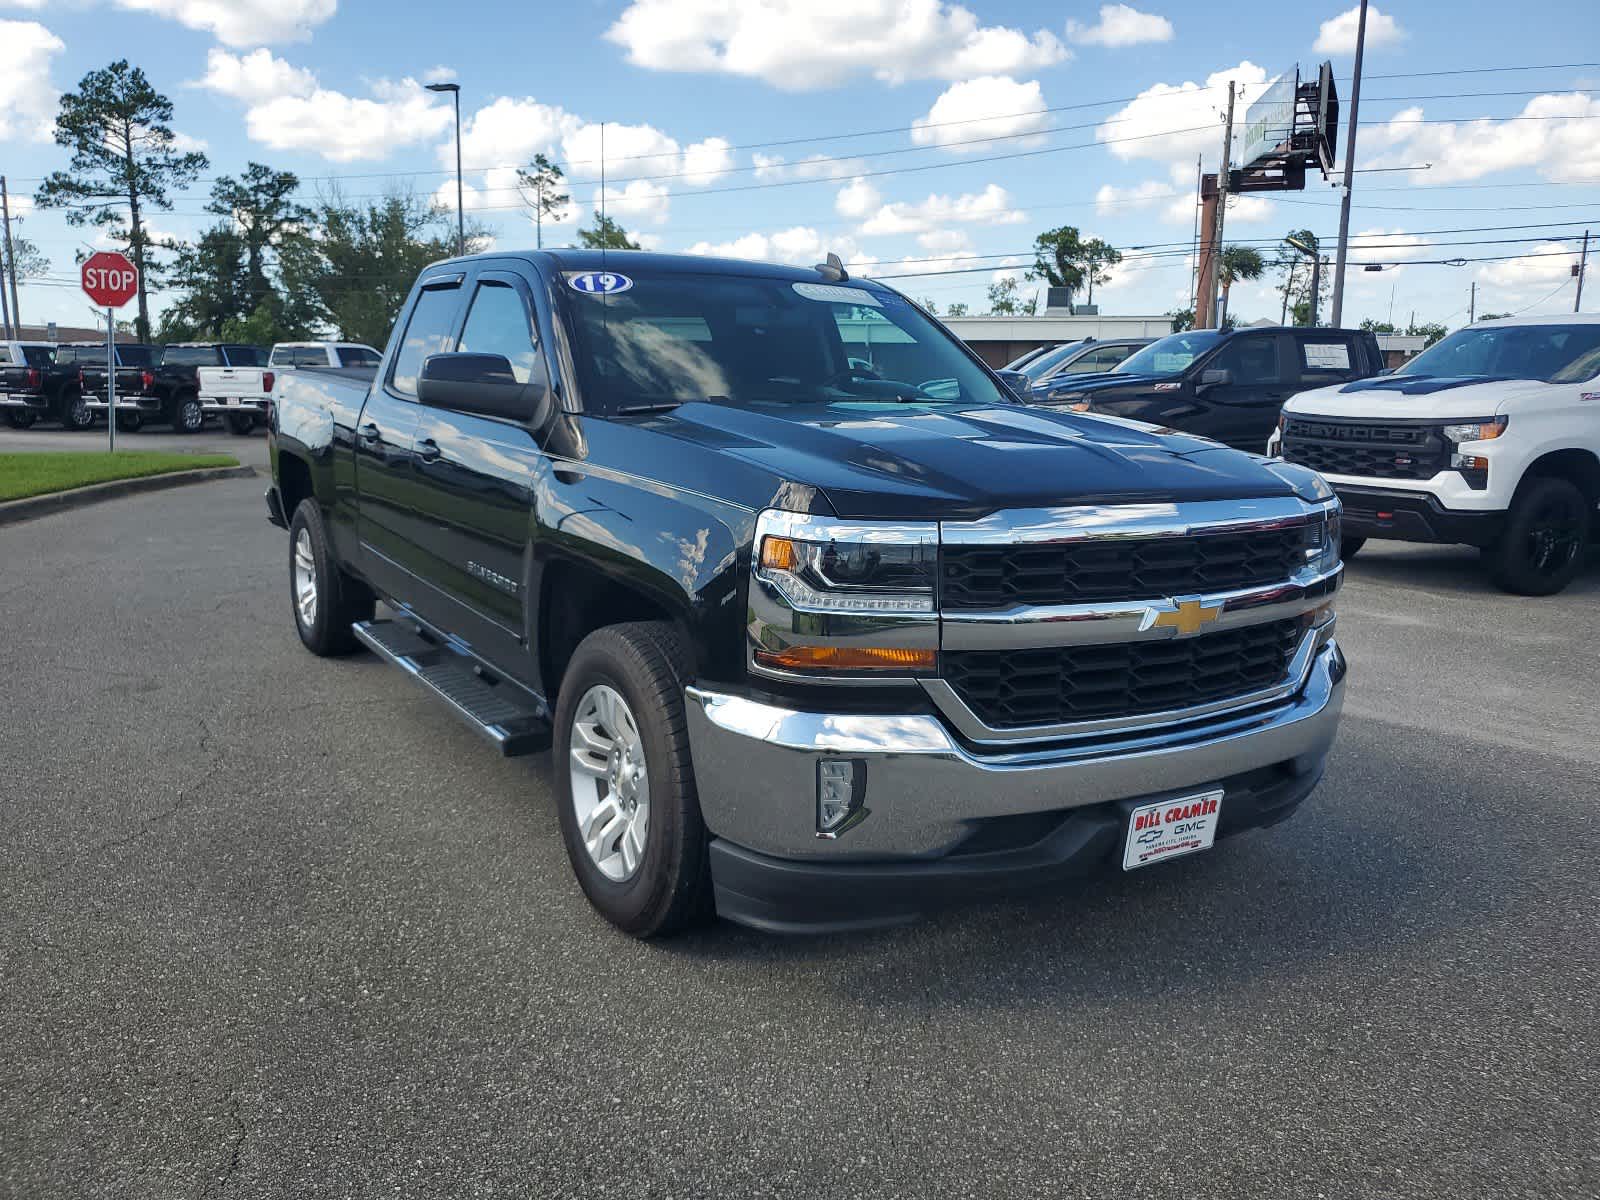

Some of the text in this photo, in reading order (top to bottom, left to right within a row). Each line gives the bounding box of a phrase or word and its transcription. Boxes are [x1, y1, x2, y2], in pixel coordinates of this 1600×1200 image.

[85, 268, 135, 291] STOP
[582, 275, 617, 291] 19
[1289, 424, 1425, 441] CHEVROLET
[1135, 800, 1217, 831] BILL CRAMER
[1174, 820, 1206, 834] GMC
